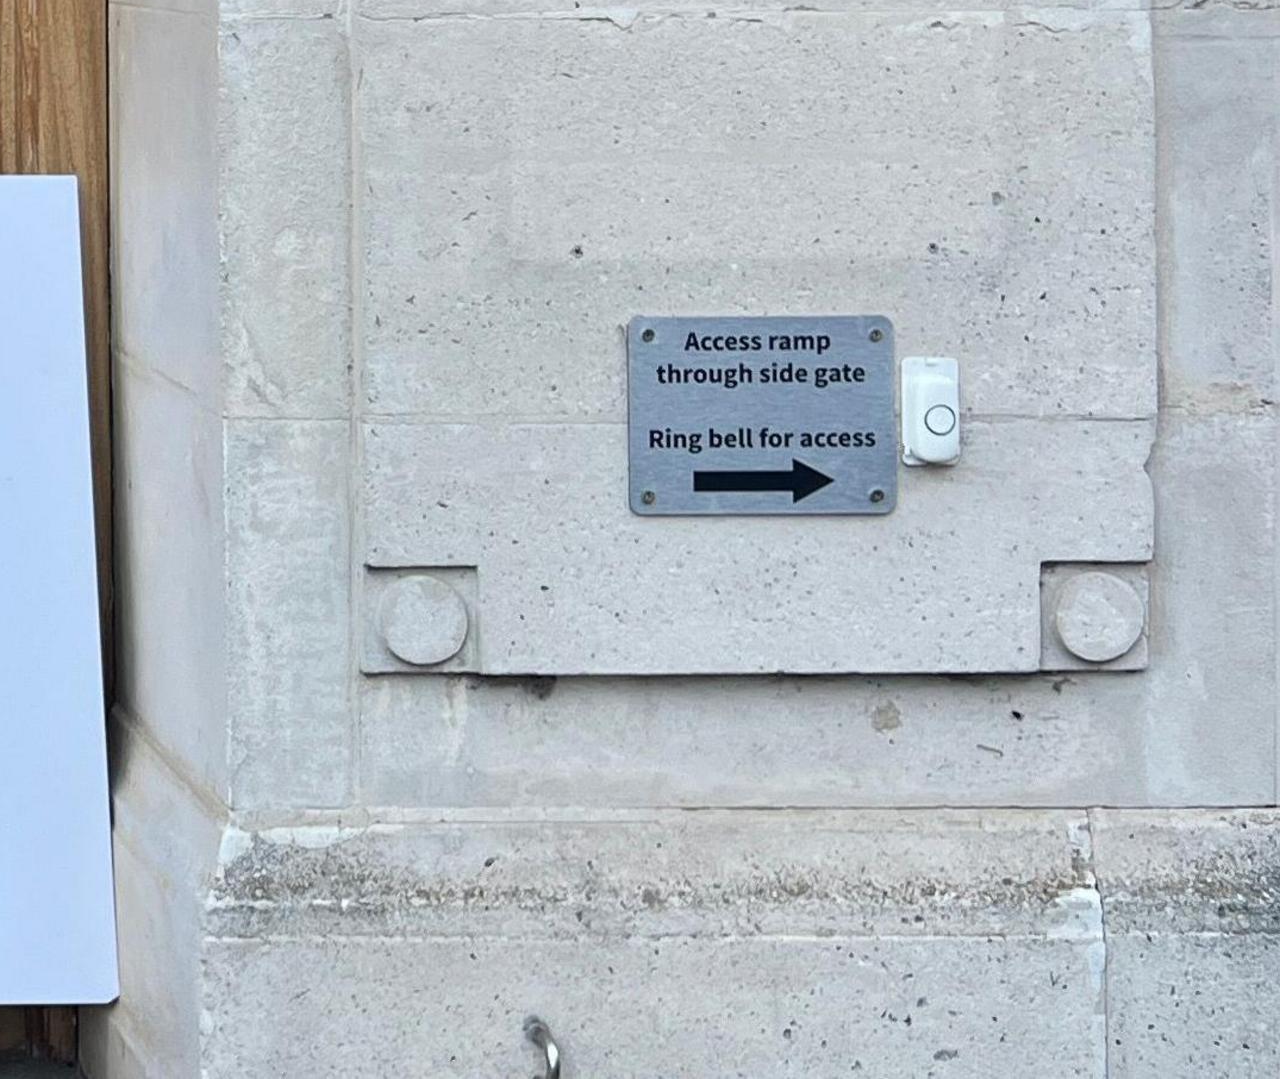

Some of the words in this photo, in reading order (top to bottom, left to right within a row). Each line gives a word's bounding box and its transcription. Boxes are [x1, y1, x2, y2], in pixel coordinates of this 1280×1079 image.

[684, 332, 762, 351] Access
[768, 335, 831, 355] ramp
[657, 363, 753, 389] through
[759, 363, 807, 383] side
[815, 365, 866, 389] gate
[649, 427, 703, 454] Ring
[708, 427, 754, 449] bell
[759, 427, 795, 448] for
[800, 432, 876, 448] access
